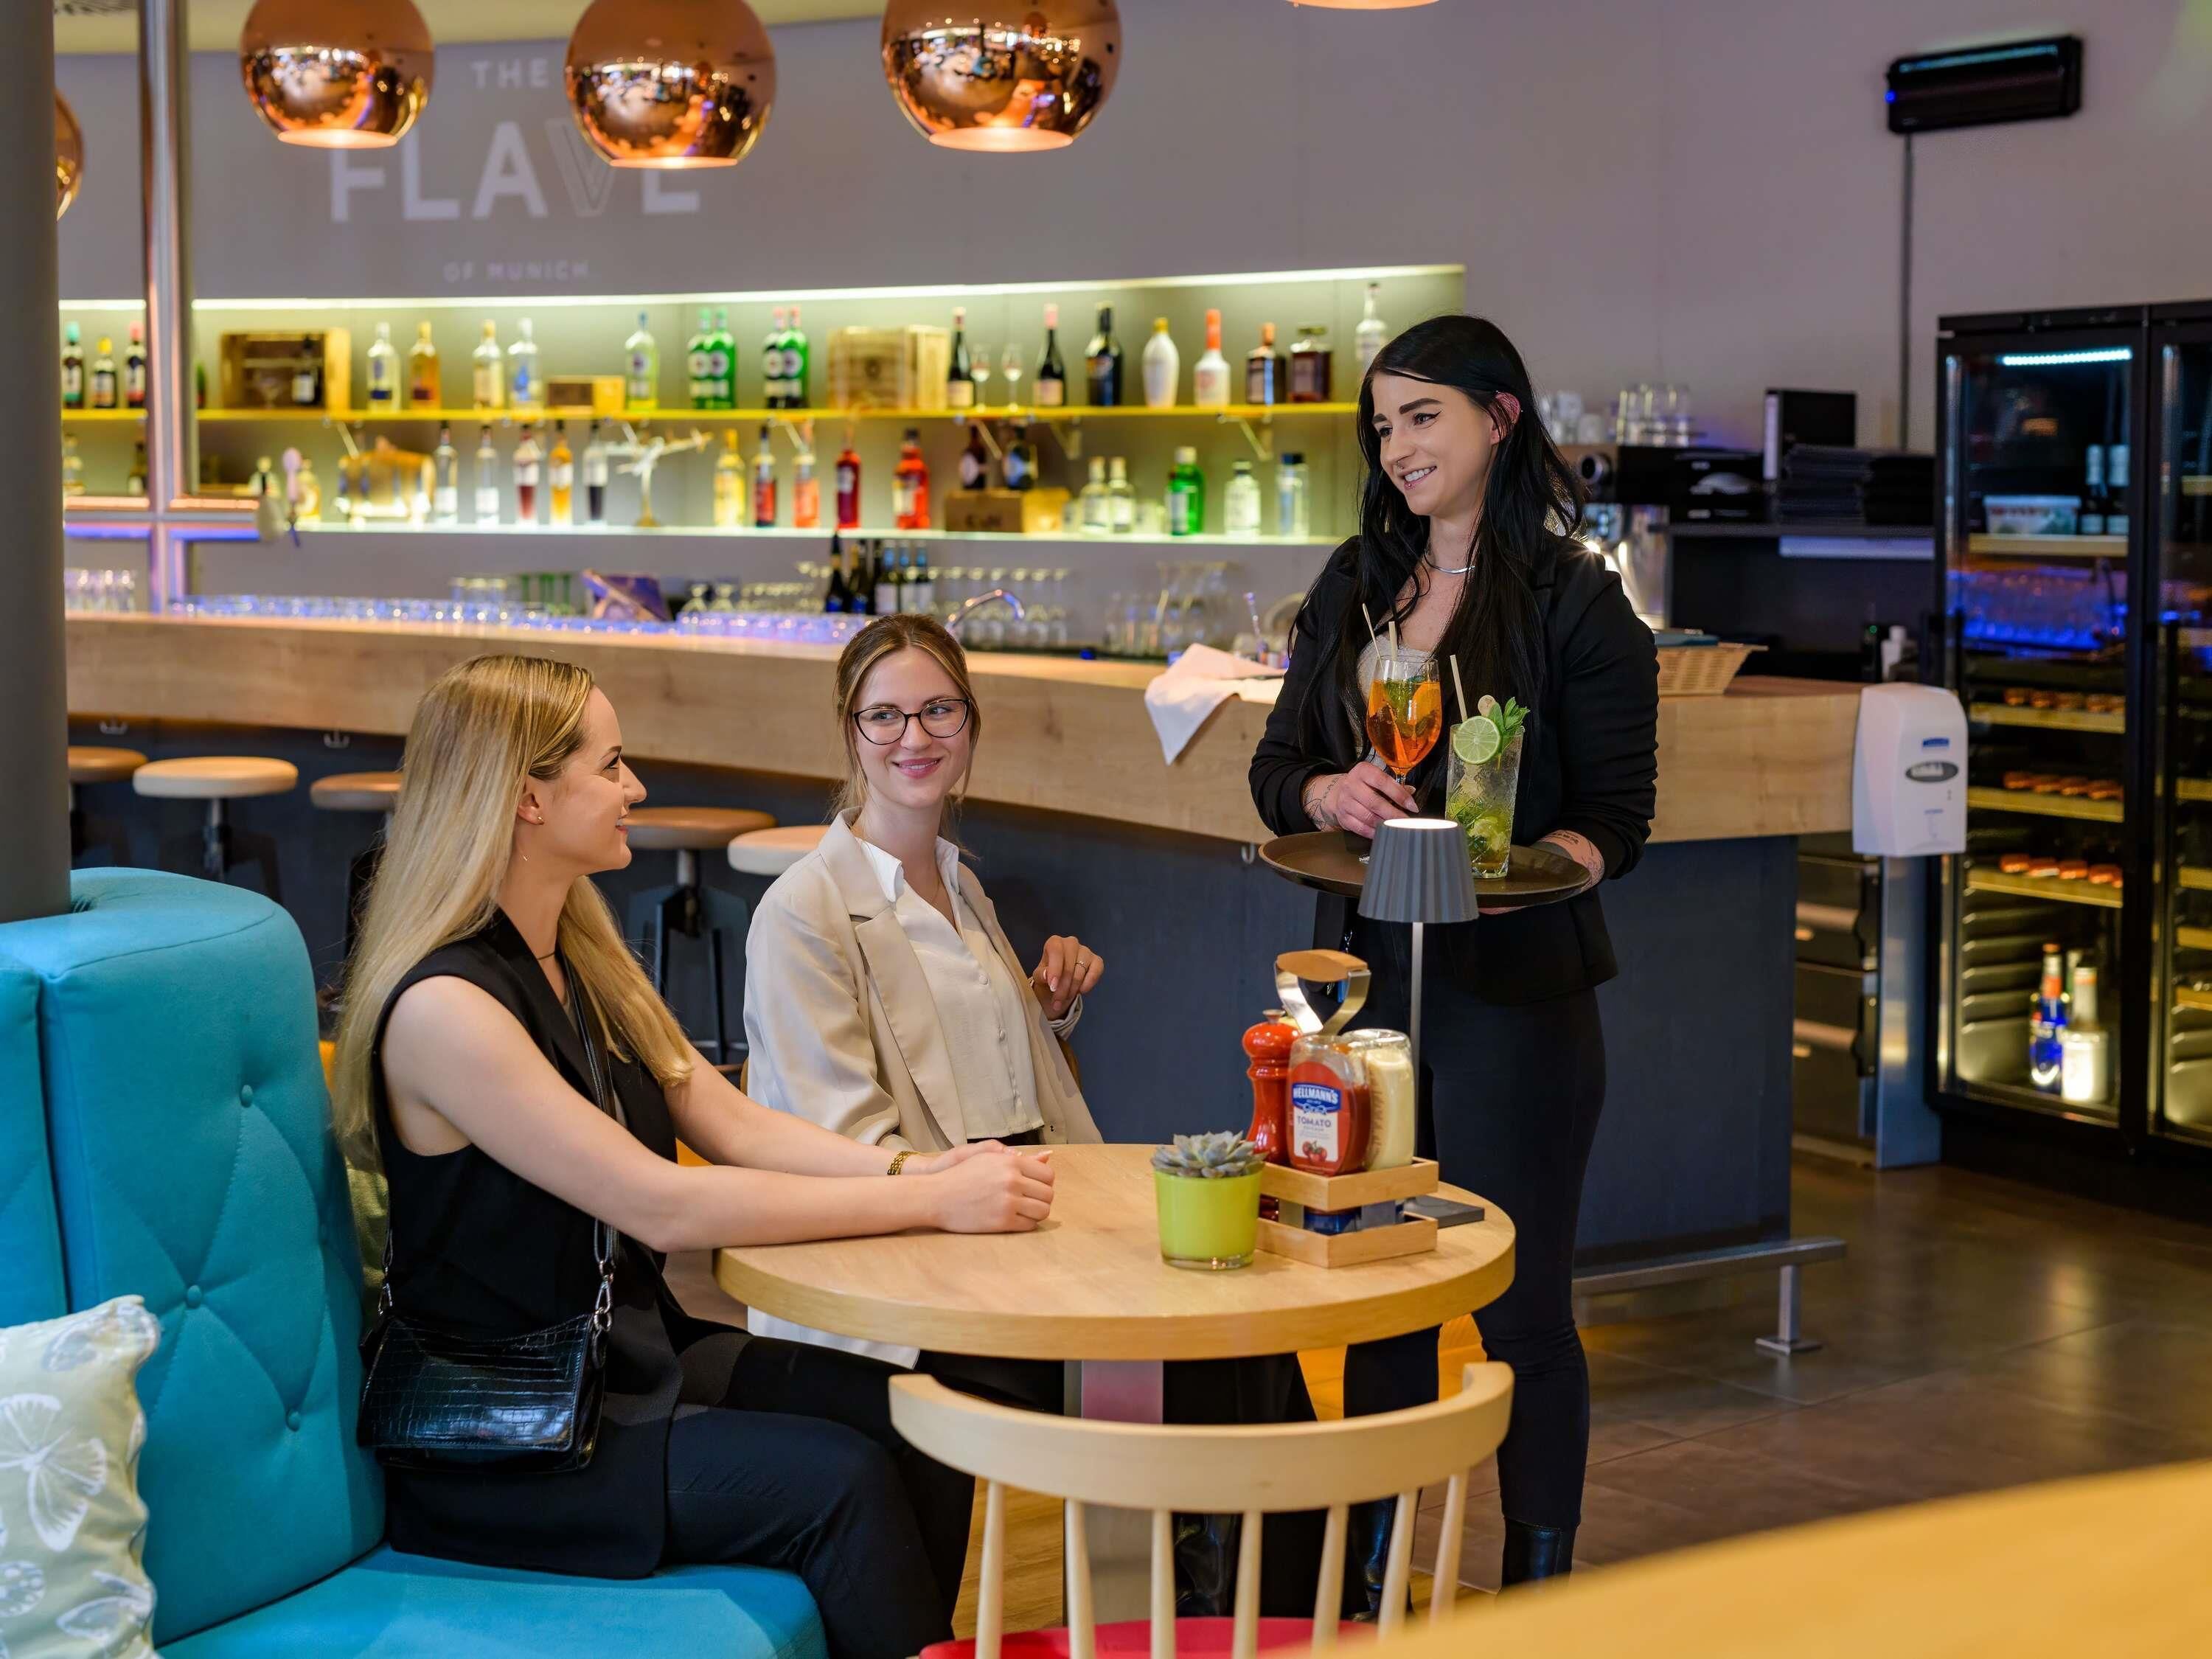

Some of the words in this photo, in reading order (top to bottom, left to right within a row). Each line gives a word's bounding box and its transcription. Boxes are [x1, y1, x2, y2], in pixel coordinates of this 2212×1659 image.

[470, 59, 549, 88] THE
[443, 260, 474, 282] OF
[487, 260, 589, 281] MUNICH
[1297, 1116, 1332, 1128] TOMATO
